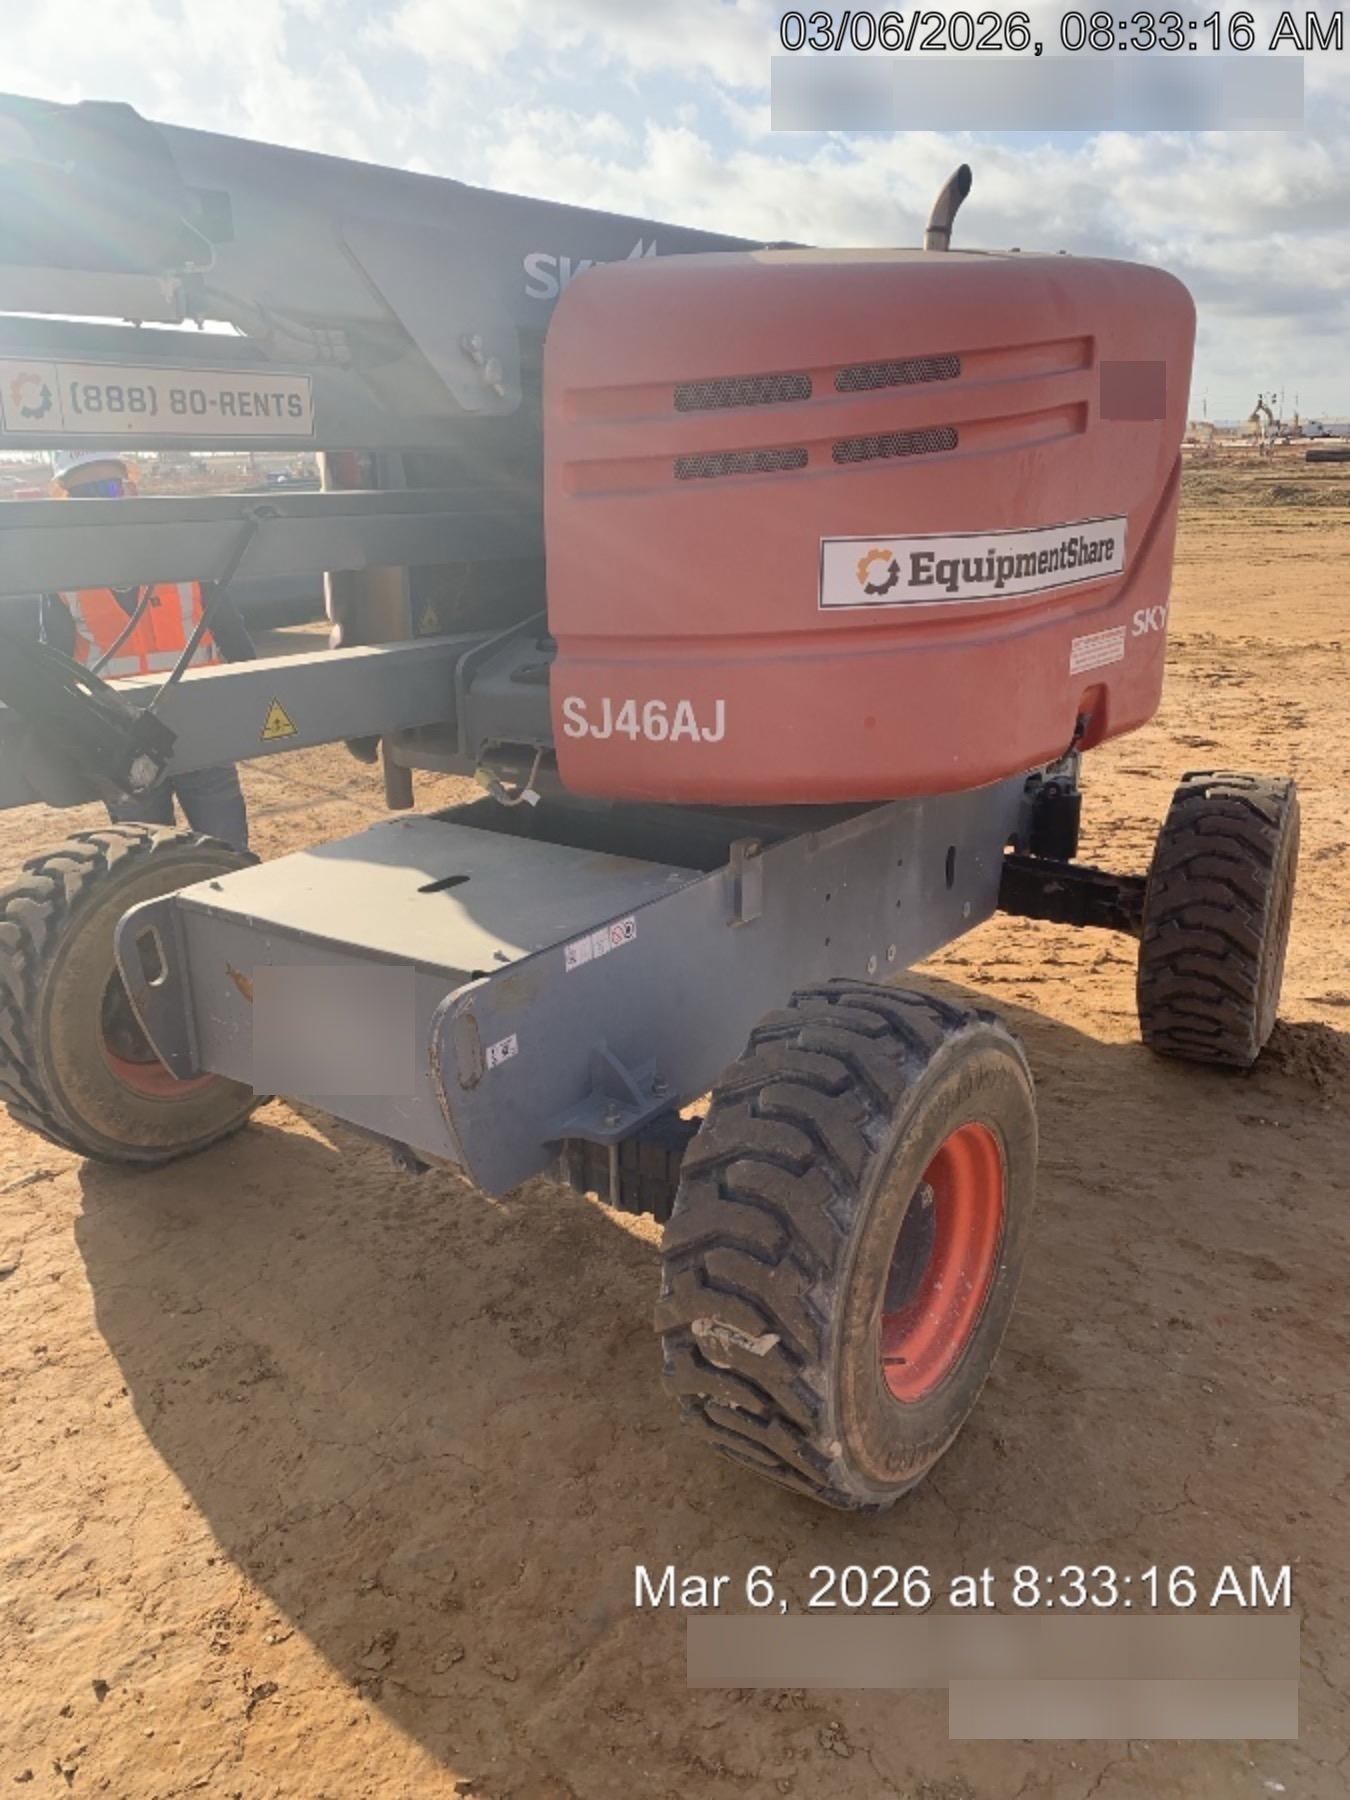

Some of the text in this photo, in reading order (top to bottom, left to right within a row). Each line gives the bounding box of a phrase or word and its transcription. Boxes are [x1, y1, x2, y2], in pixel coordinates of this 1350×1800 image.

[69, 381, 303, 418] (888) 80-RENTS
[907, 536, 1115, 593] EquipmentShare
[562, 696, 726, 742] SJ46AJ
